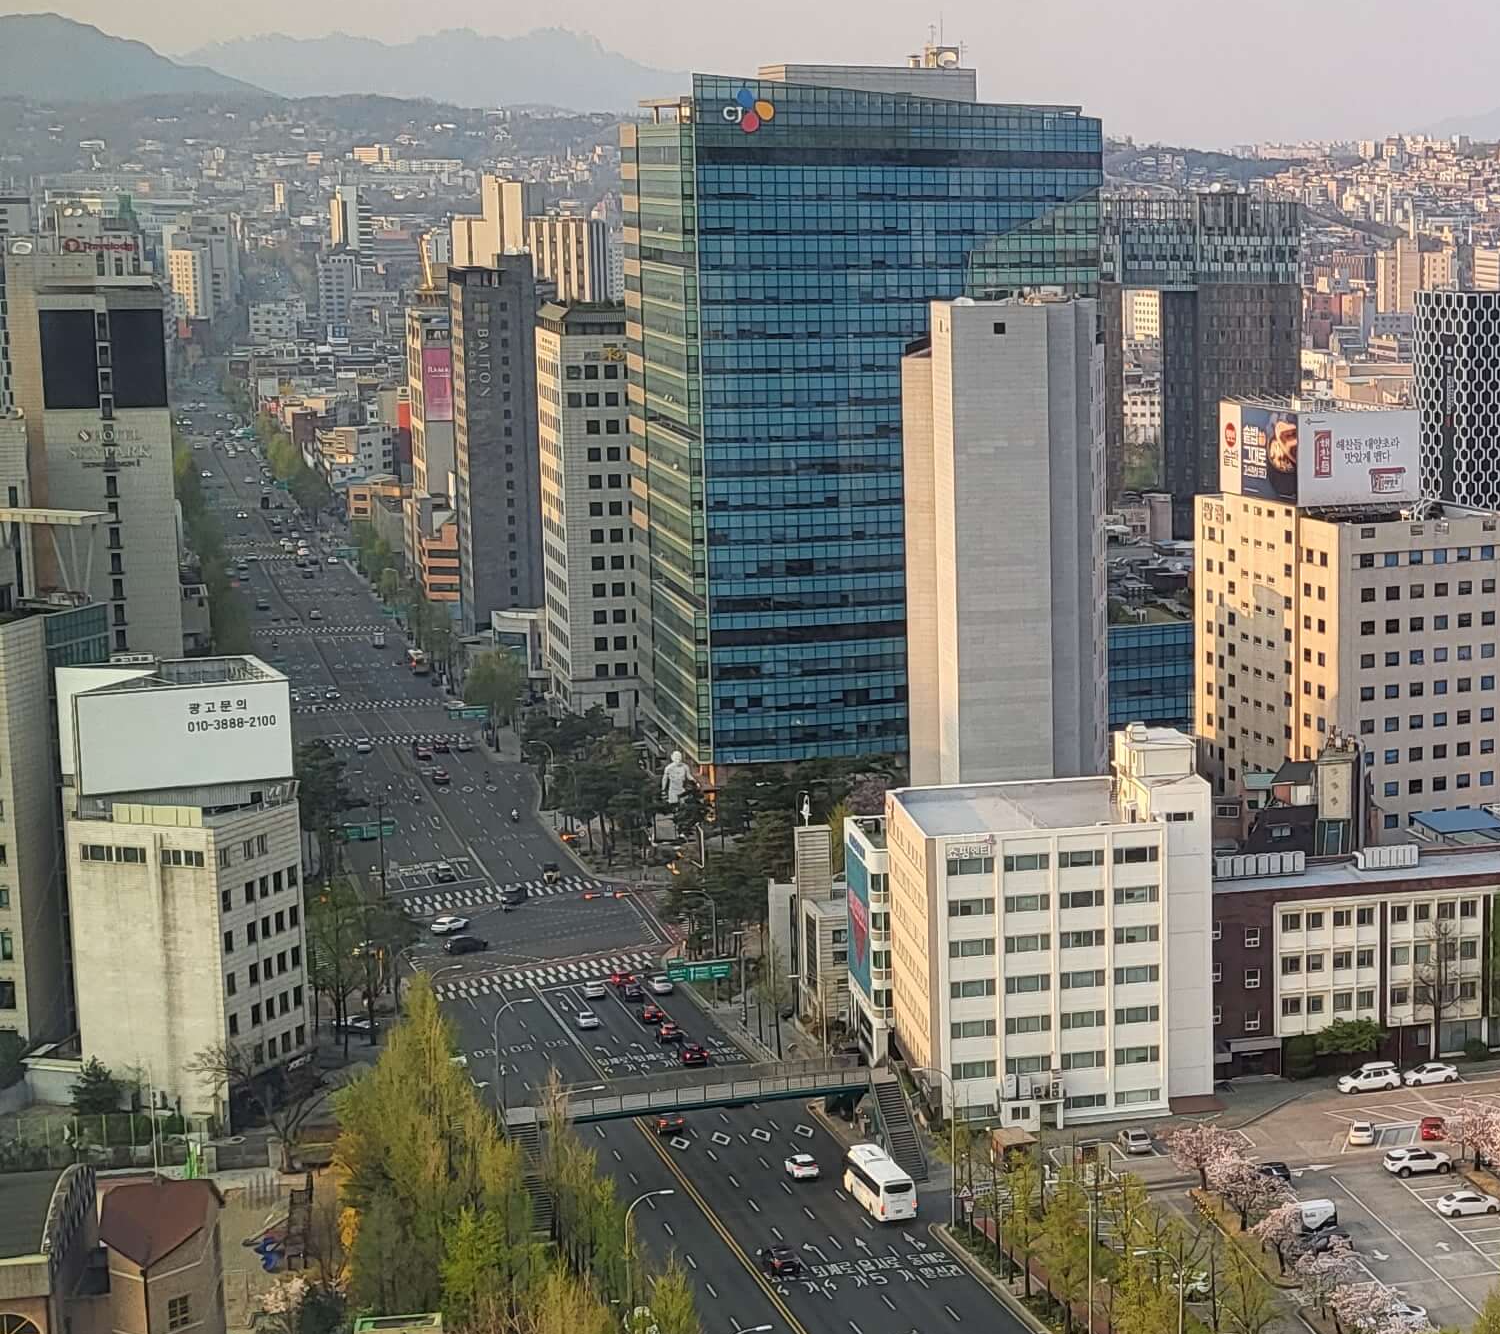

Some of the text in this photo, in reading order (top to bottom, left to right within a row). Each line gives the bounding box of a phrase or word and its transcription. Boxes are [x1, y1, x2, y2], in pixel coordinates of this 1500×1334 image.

[723, 106, 743, 123] CJ
[478, 328, 491, 397] BAITON
[95, 429, 143, 441] HOTEL
[67, 445, 152, 460] SKYPARK
[188, 698, 248, 715] 광고문의
[187, 714, 277, 732] 010-3888-2100
[947, 844, 991, 859] 쇼핑엔티
